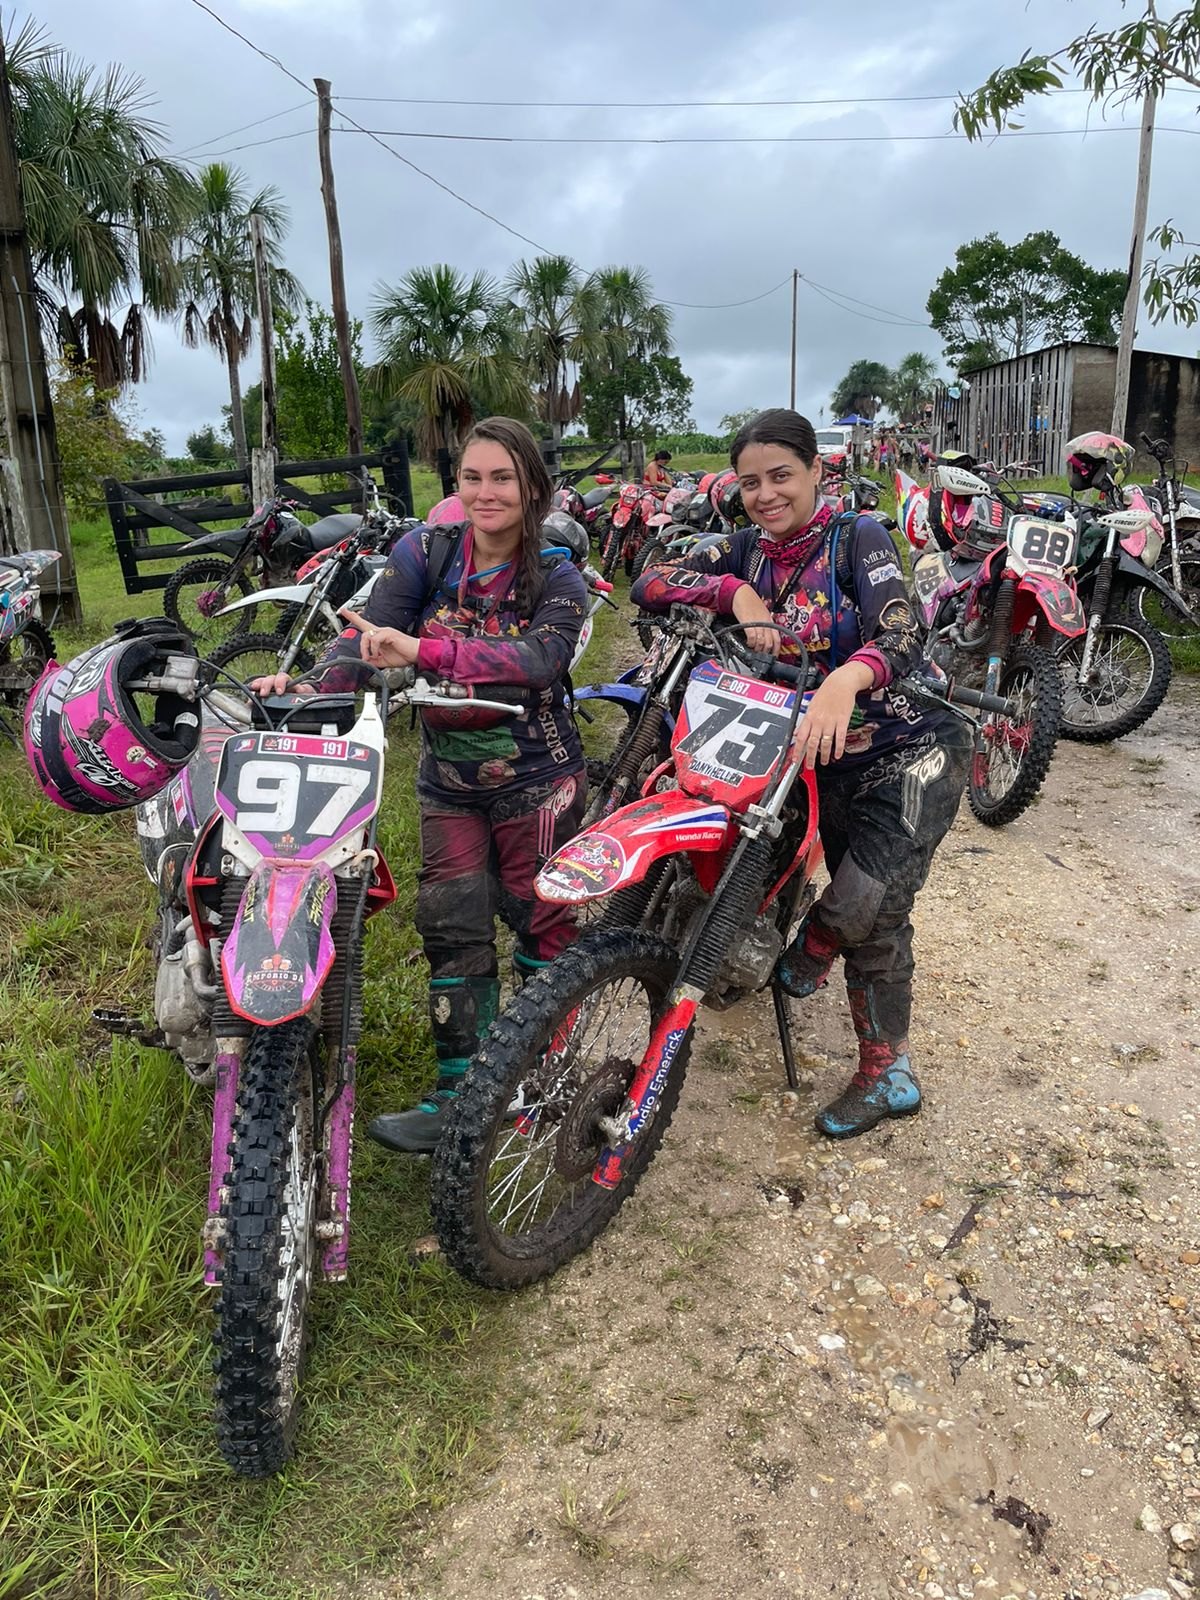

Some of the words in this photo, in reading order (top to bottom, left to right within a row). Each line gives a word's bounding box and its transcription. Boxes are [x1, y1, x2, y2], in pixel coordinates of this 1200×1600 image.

[956, 480, 979, 489] CIRCUIT
[1021, 527, 1070, 566] 88
[730, 680, 750, 694] 087
[764, 690, 785, 705] 087
[277, 738, 298, 751] 191
[322, 741, 343, 755] 191
[676, 693, 790, 776] 73
[236, 760, 371, 836] 97
[675, 833, 702, 842] Honda
[292, 973, 304, 983] DA
[649, 1029, 686, 1092] Emerick.
